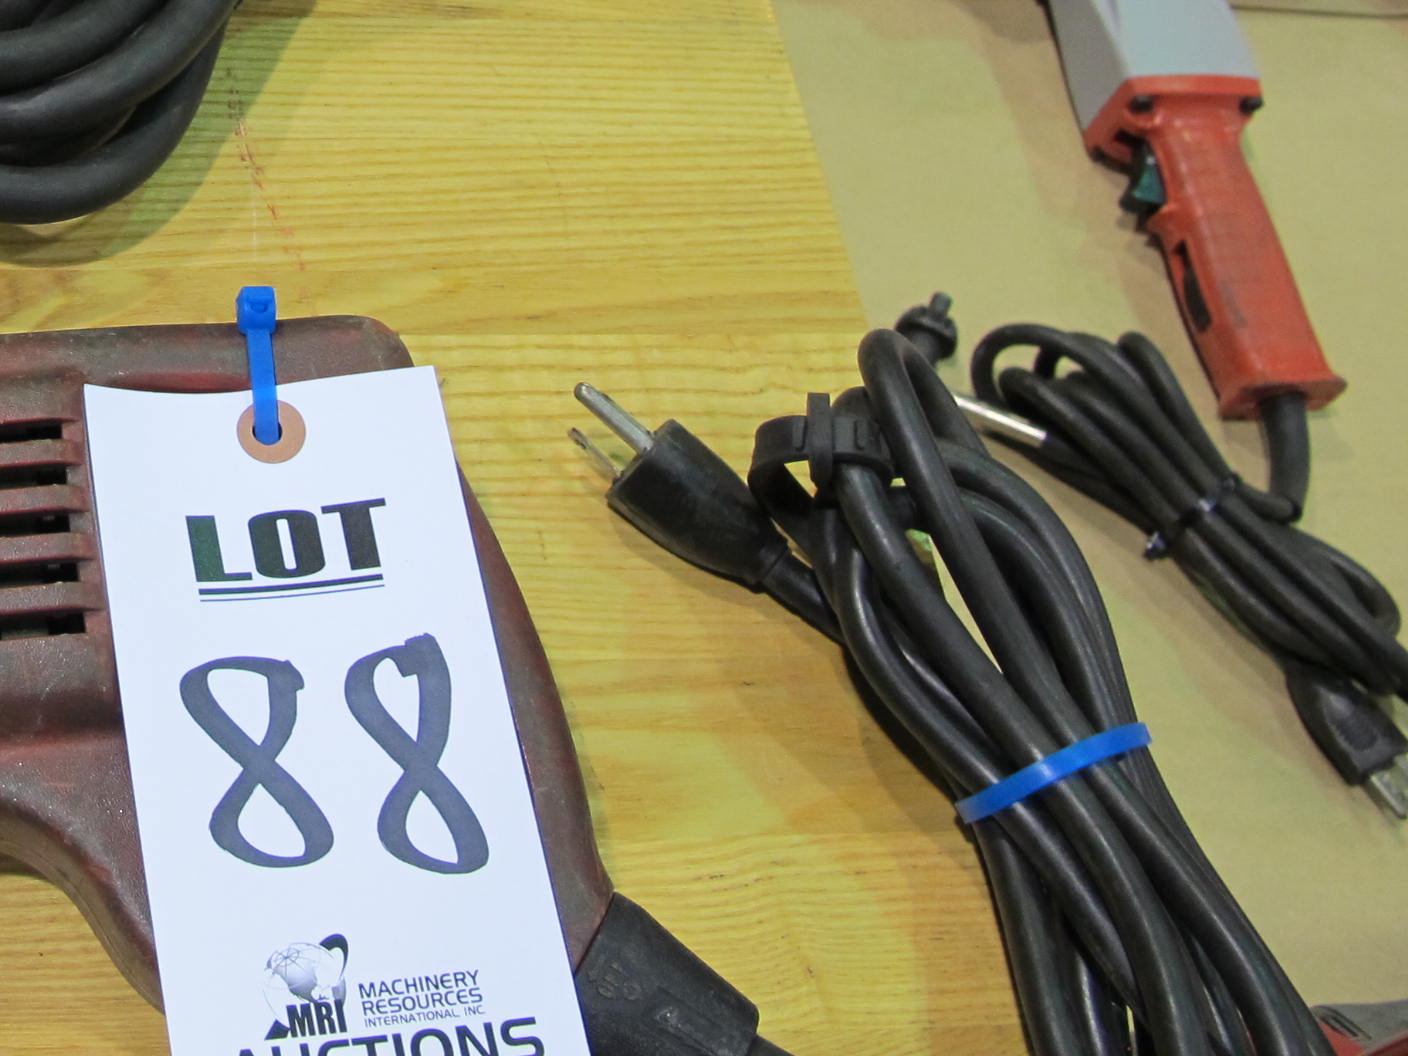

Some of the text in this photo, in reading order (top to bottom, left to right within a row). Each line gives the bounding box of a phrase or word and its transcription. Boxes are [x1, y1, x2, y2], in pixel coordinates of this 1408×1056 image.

[185, 498, 387, 583] LOT
[179, 632, 489, 875] 88
[358, 969, 479, 999] MACHINERY
[362, 987, 483, 1016] RESOURCES
[240, 1016, 545, 1056] IONS
[286, 998, 348, 1039] MRI
[364, 1007, 460, 1028] INTERNATIONAL
